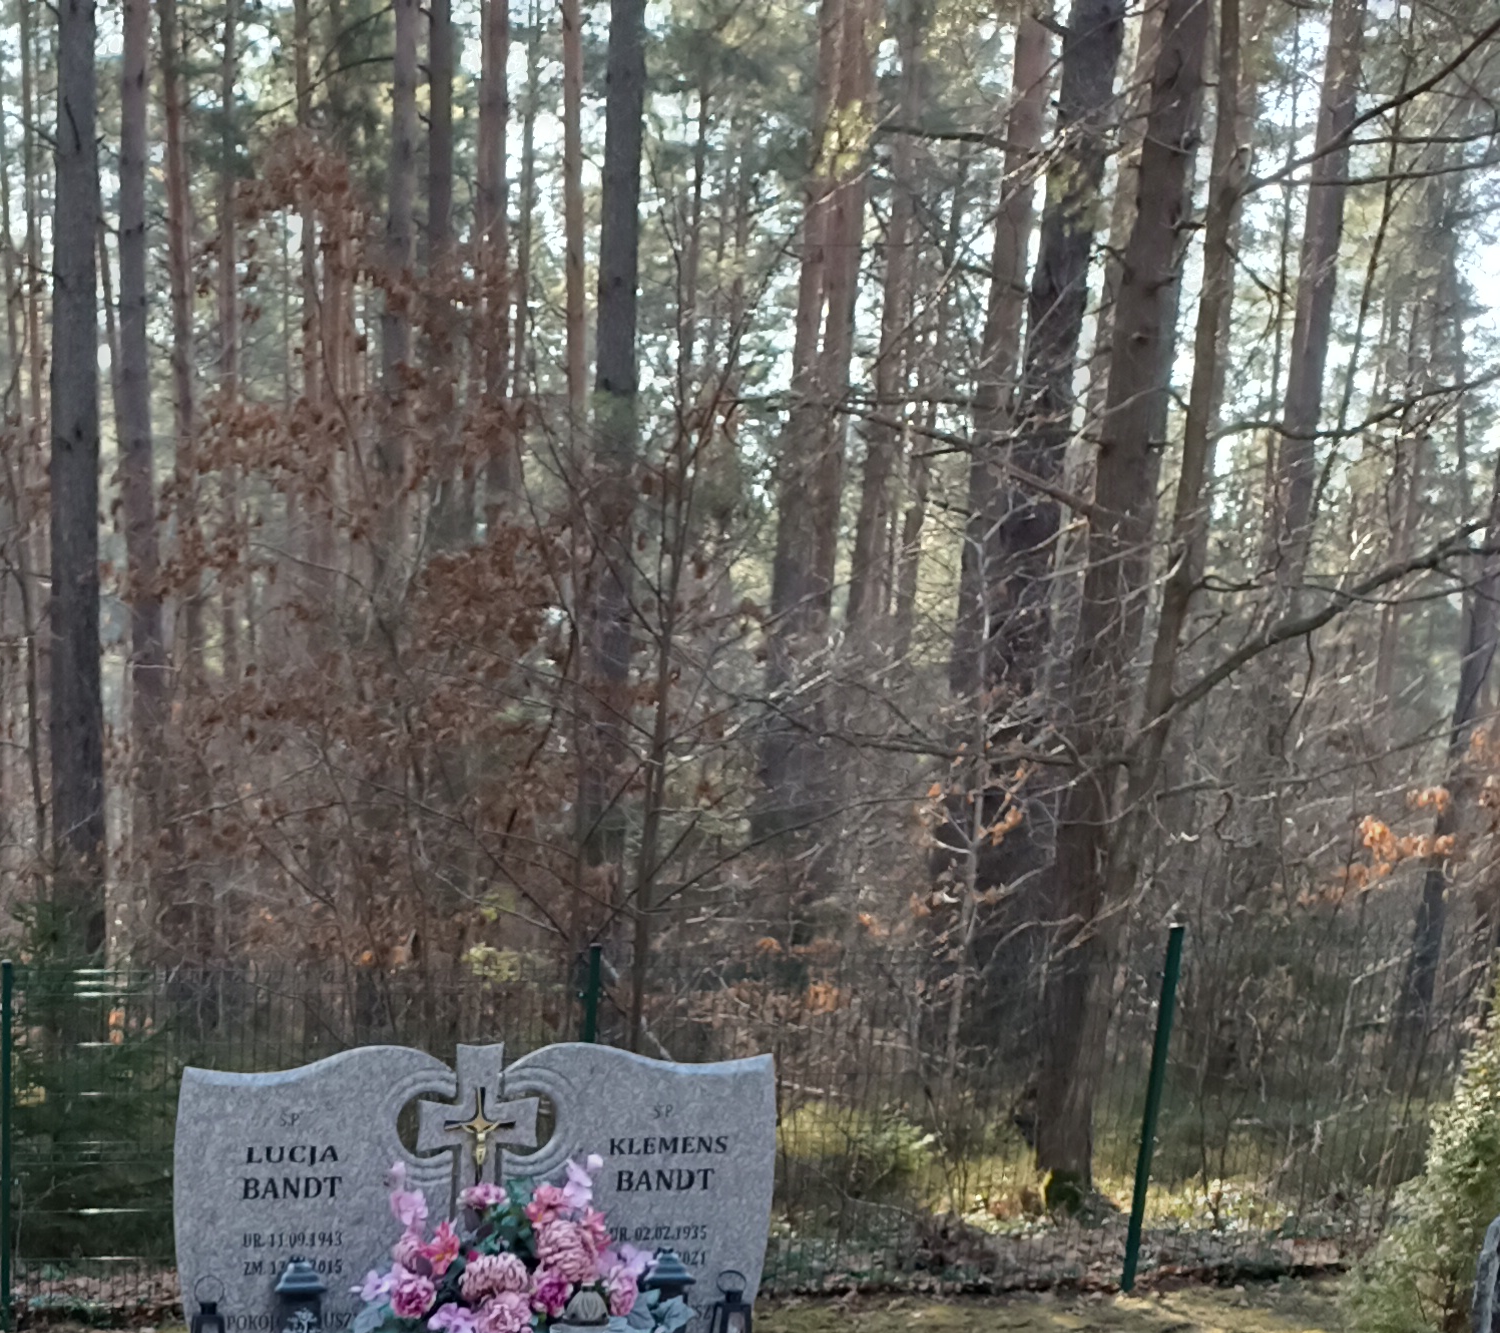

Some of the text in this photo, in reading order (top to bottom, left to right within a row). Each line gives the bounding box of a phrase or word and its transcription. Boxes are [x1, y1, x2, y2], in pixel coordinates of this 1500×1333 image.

[245, 1144, 339, 1167] LUCJA
[608, 1135, 729, 1156] KLEMENS
[242, 1175, 343, 1200] BANDT
[615, 1167, 716, 1192] BANDT
